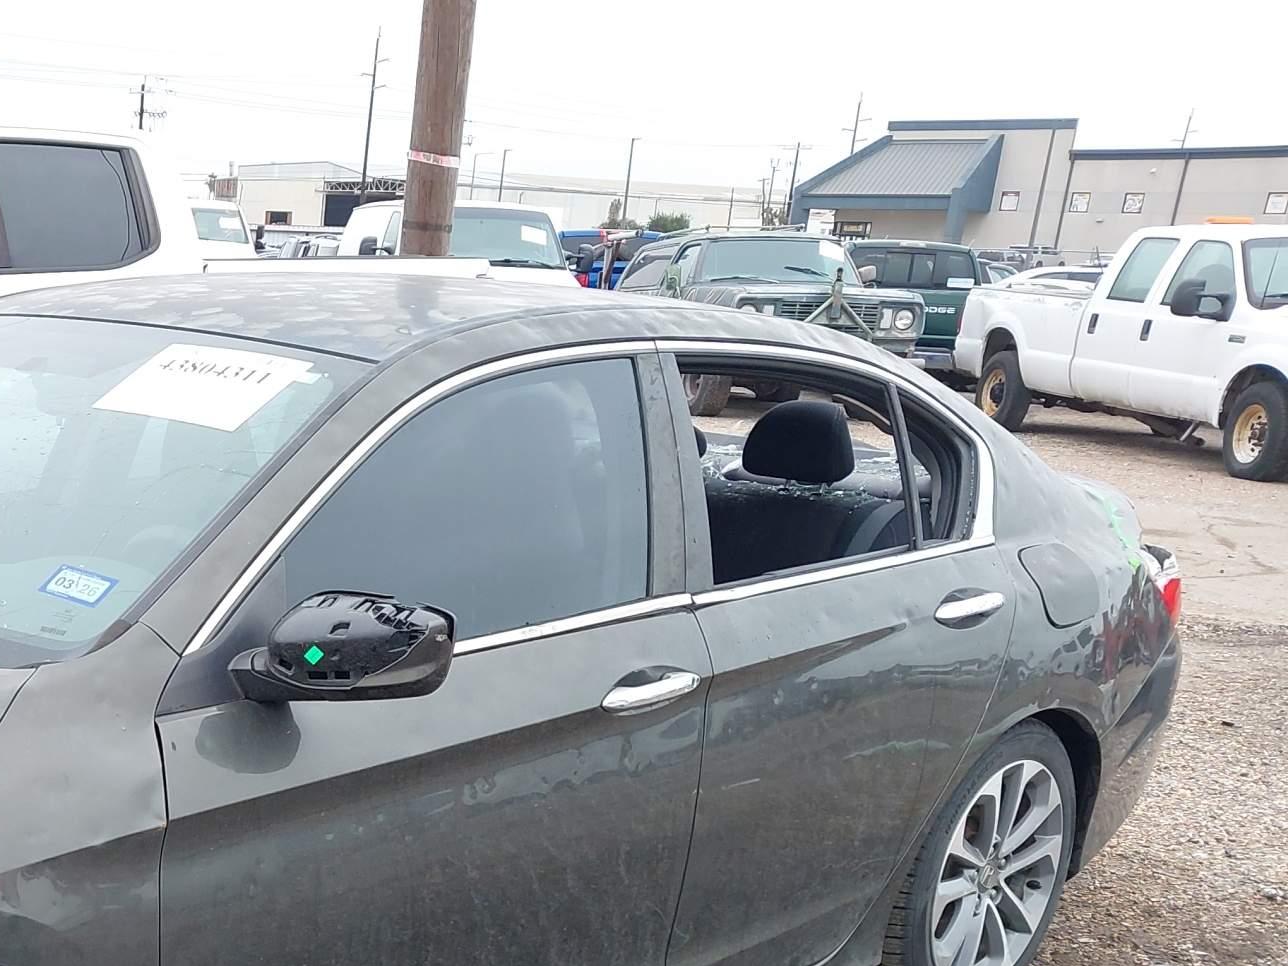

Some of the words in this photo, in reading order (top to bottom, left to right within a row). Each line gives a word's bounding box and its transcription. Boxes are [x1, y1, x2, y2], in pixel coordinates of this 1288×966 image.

[923, 305, 956, 315] ODGE
[160, 359, 272, 385] 43804311
[54, 575, 76, 590] 03
[79, 582, 100, 598] 26
